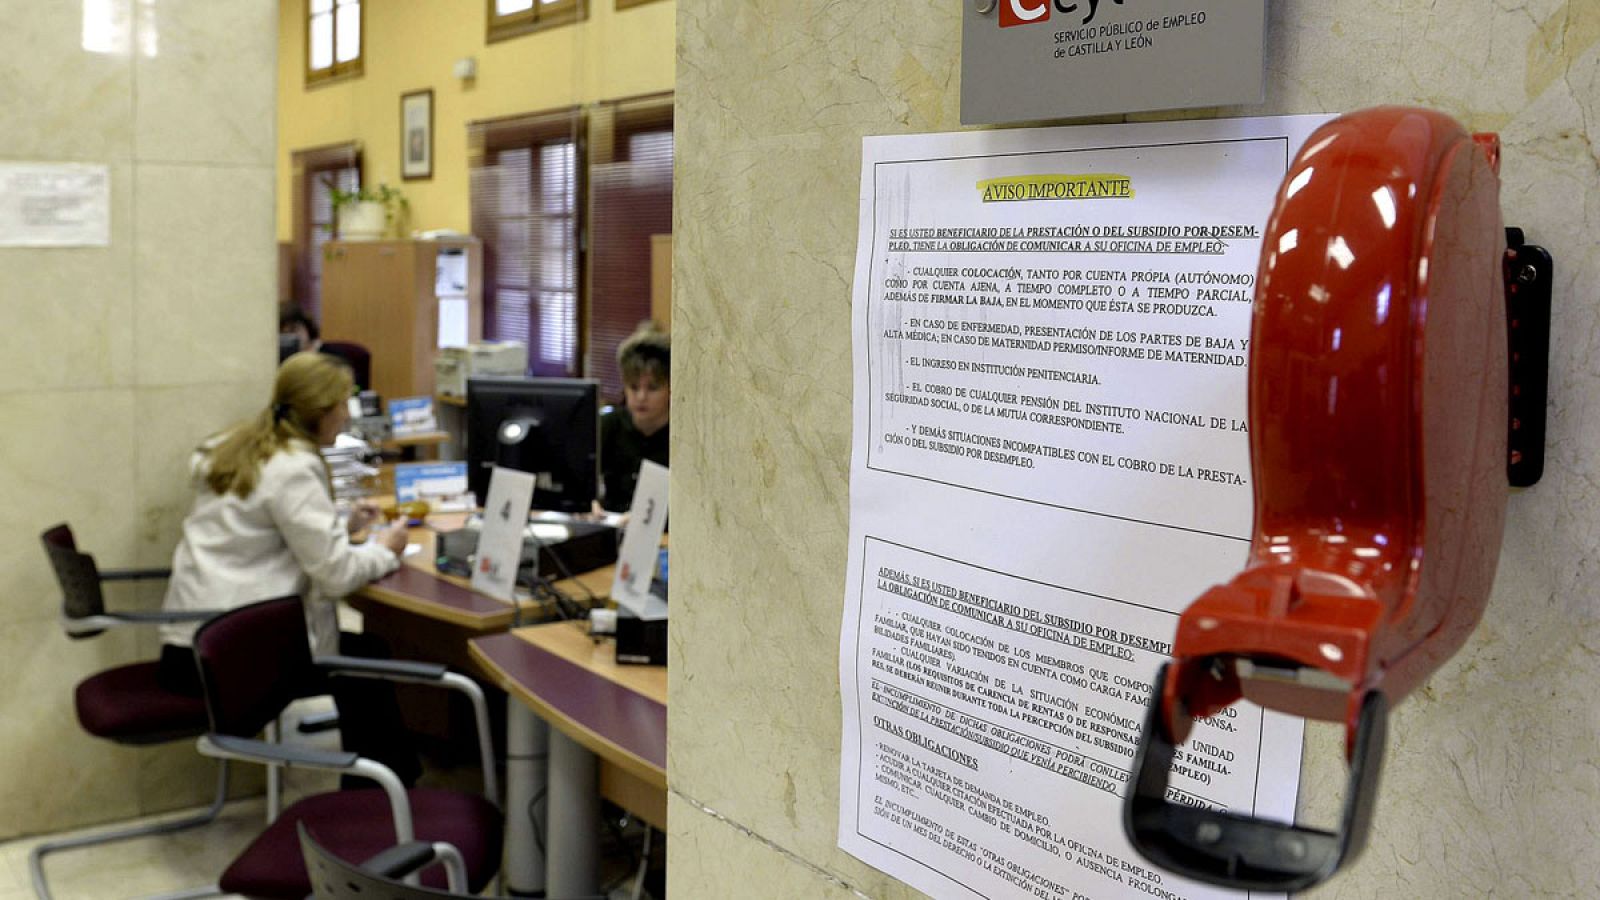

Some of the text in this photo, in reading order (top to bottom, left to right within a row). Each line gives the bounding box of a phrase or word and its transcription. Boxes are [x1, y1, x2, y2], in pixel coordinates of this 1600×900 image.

[1054, 11, 1206, 44] SERVICIO PÚBLICO de EMPLEO
[1054, 35, 1152, 58] de CASTILLA Y LEÓN
[983, 179, 1130, 200] AVISO IMPORTANTE
[908, 229, 935, 238] USTED
[936, 228, 997, 238] BENEFICIARIO
[1000, 227, 1012, 237] DE
[1012, 227, 1024, 237] LA
[1026, 223, 1090, 237] PRESTACIÓN
[1092, 226, 1101, 236] O
[1103, 226, 1123, 236] DEL
[1127, 226, 1180, 236] SUBSIDIO
[1211, 226, 1260, 236] DESEM-
[914, 242, 935, 250] TIENE
[936, 242, 948, 250] LA
[950, 238, 1005, 250] OBLIGACIÓN
[1006, 242, 1018, 250] DE
[1020, 242, 1082, 250] COMUNICAR
[1084, 242, 1092, 251] A
[1094, 242, 1108, 251] SU
[1110, 242, 1152, 252] OFICINA
[1156, 242, 1171, 252] DE
[912, 267, 958, 279] CUALQUIER
[961, 266, 1023, 281] COLOCACIÓN,
[1026, 270, 1060, 280] TANTO
[1063, 271, 1082, 280] POR
[1086, 271, 1126, 281] CUENTA
[1175, 271, 1254, 287] (AUTÓNOMO)
[884, 290, 1218, 316] ADEMÁS DE FIRMAR LA BAJA, EN EL MOMENTO QUE ÉSTA SE PRODUZCA.
[885, 279, 1252, 304] COMO POR CUENTA AJENA, A TIEMPO COMPLETO O A TIEMPO PARCIAL,
[883, 329, 1247, 366] ALTA MÉDICA; EN CASO DE MATERNIDAD PERMISO/INFORME DE MATERNIDAD.
[910, 318, 1249, 350] EN CASO DE ENFERMEDAD, PRESENTACIÓN DE LOS PARTES DE BAJA Y
[910, 357, 1101, 385] EL INGRESO EN INSTITUCIÓN PENITENCIARIA.
[884, 392, 1124, 434] SEGURIDAD SOCIAL, O DE LA MUTUA CORRESPONDIENTE.
[912, 383, 1249, 432] EL COBRO DE CUALQUIER PENSIÓN DEL INSTITUTO NACIONAL DE LA
[884, 431, 1035, 469] CIÓN O DEL SUBSIDIO POR DESEMPLEO.
[911, 425, 1247, 485] Y DEMÁS SITUACIONES INCOMPATIBLES CON EL COBRO DE LA PRESTA-
[888, 583, 938, 607] OBLIGACIÓN
[940, 599, 950, 610] DE
[951, 602, 1005, 627] COMUNICAR
[1007, 619, 1014, 630] A
[1016, 621, 1028, 633] SU
[1030, 625, 1070, 644] OFICINA
[1073, 635, 1087, 649] DE
[922, 579, 930, 591] ES
[932, 581, 957, 599] USTED
[958, 589, 1021, 617] BENEFICIARIO
[1023, 607, 1041, 621] DEL
[1044, 612, 1093, 635] SUBSIDIO
[1096, 625, 1118, 641] POR
[1021, 662, 1122, 699] CUENTA COMO CARGA
[1035, 653, 1109, 682] MIEMBROS QUE
[1084, 706, 1142, 733] ECONÓMICA
[873, 715, 978, 770] OTRAS OBLIGACIONES
[1093, 737, 1134, 758] SUBSIDIO
[1192, 740, 1235, 762] UNIDAD
[1186, 754, 1232, 775] FAMILIA-
[1076, 857, 1123, 883] AUSENCIA
